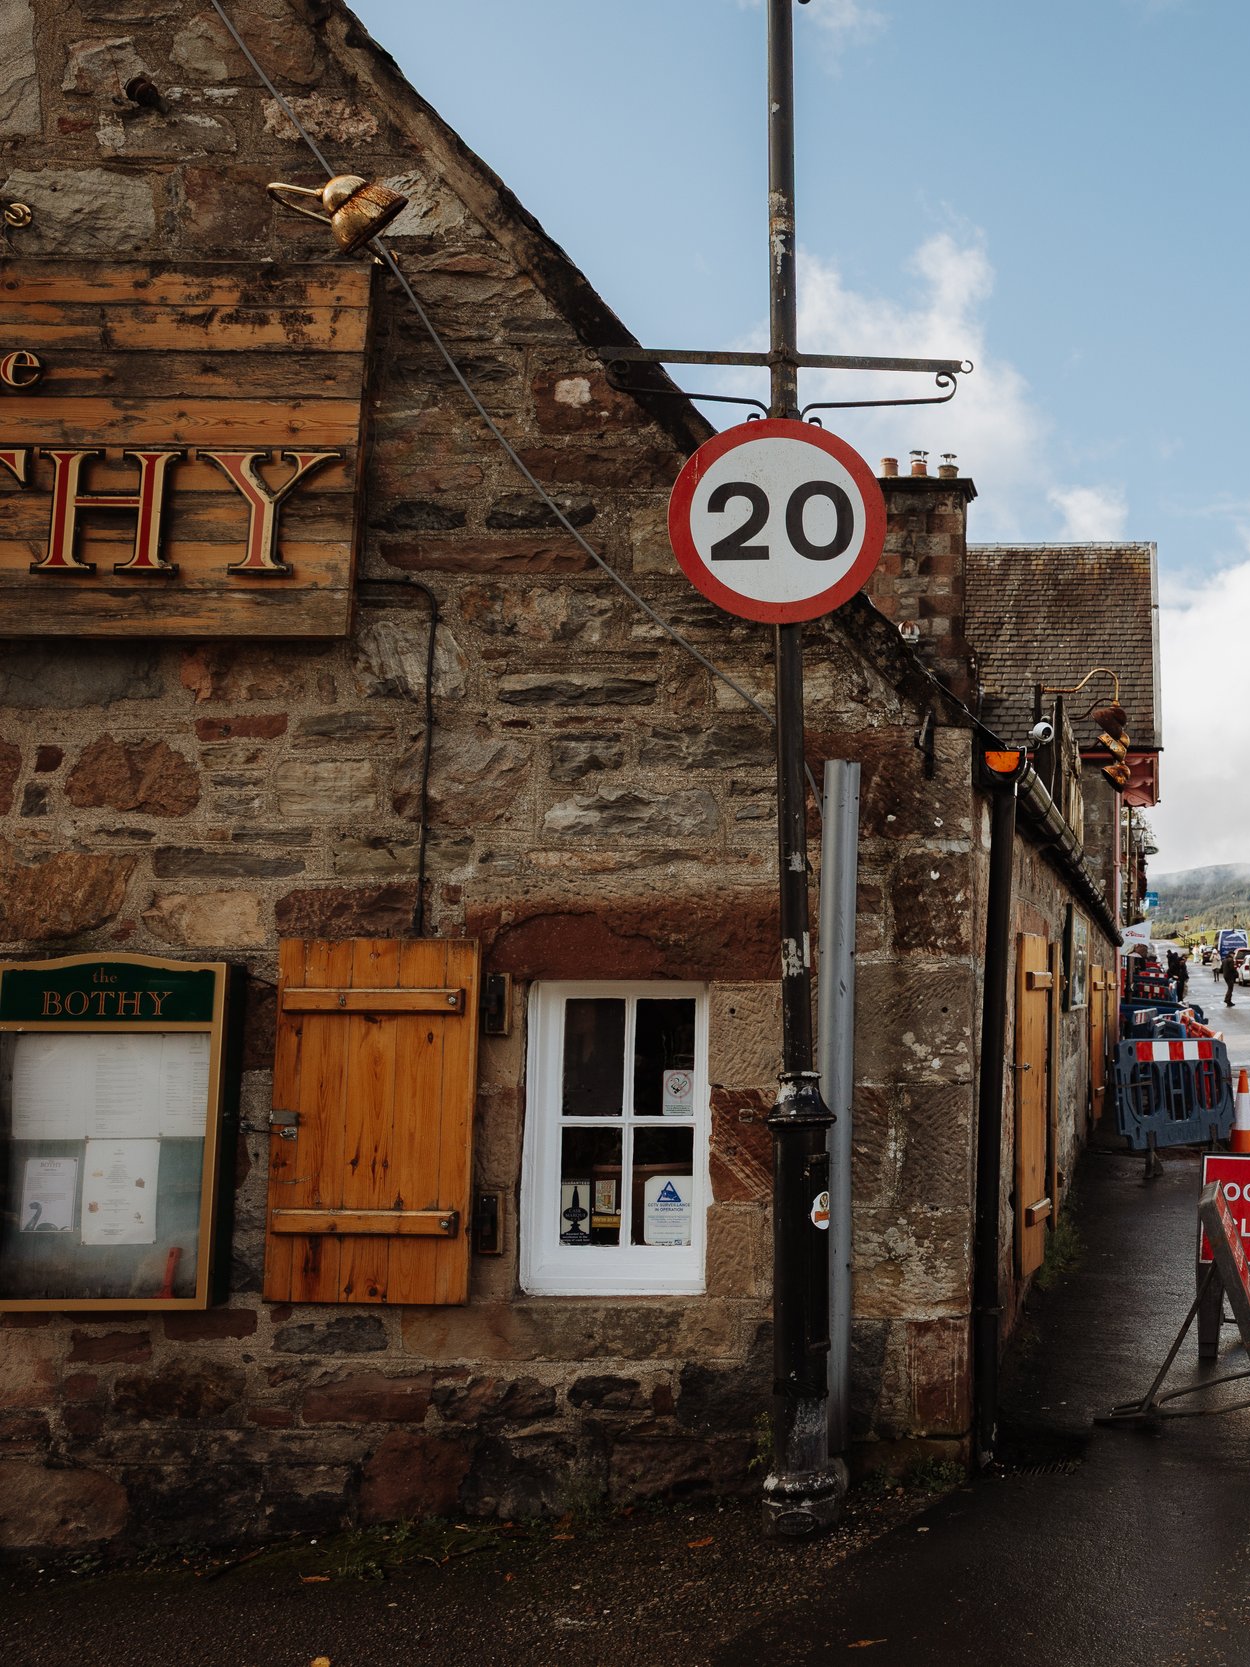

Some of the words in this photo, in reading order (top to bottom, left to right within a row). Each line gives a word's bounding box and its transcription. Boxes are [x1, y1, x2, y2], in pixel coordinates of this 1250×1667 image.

[706, 480, 855, 562] 20
[92, 968, 118, 984] the
[41, 991, 174, 1016] BOTHY
